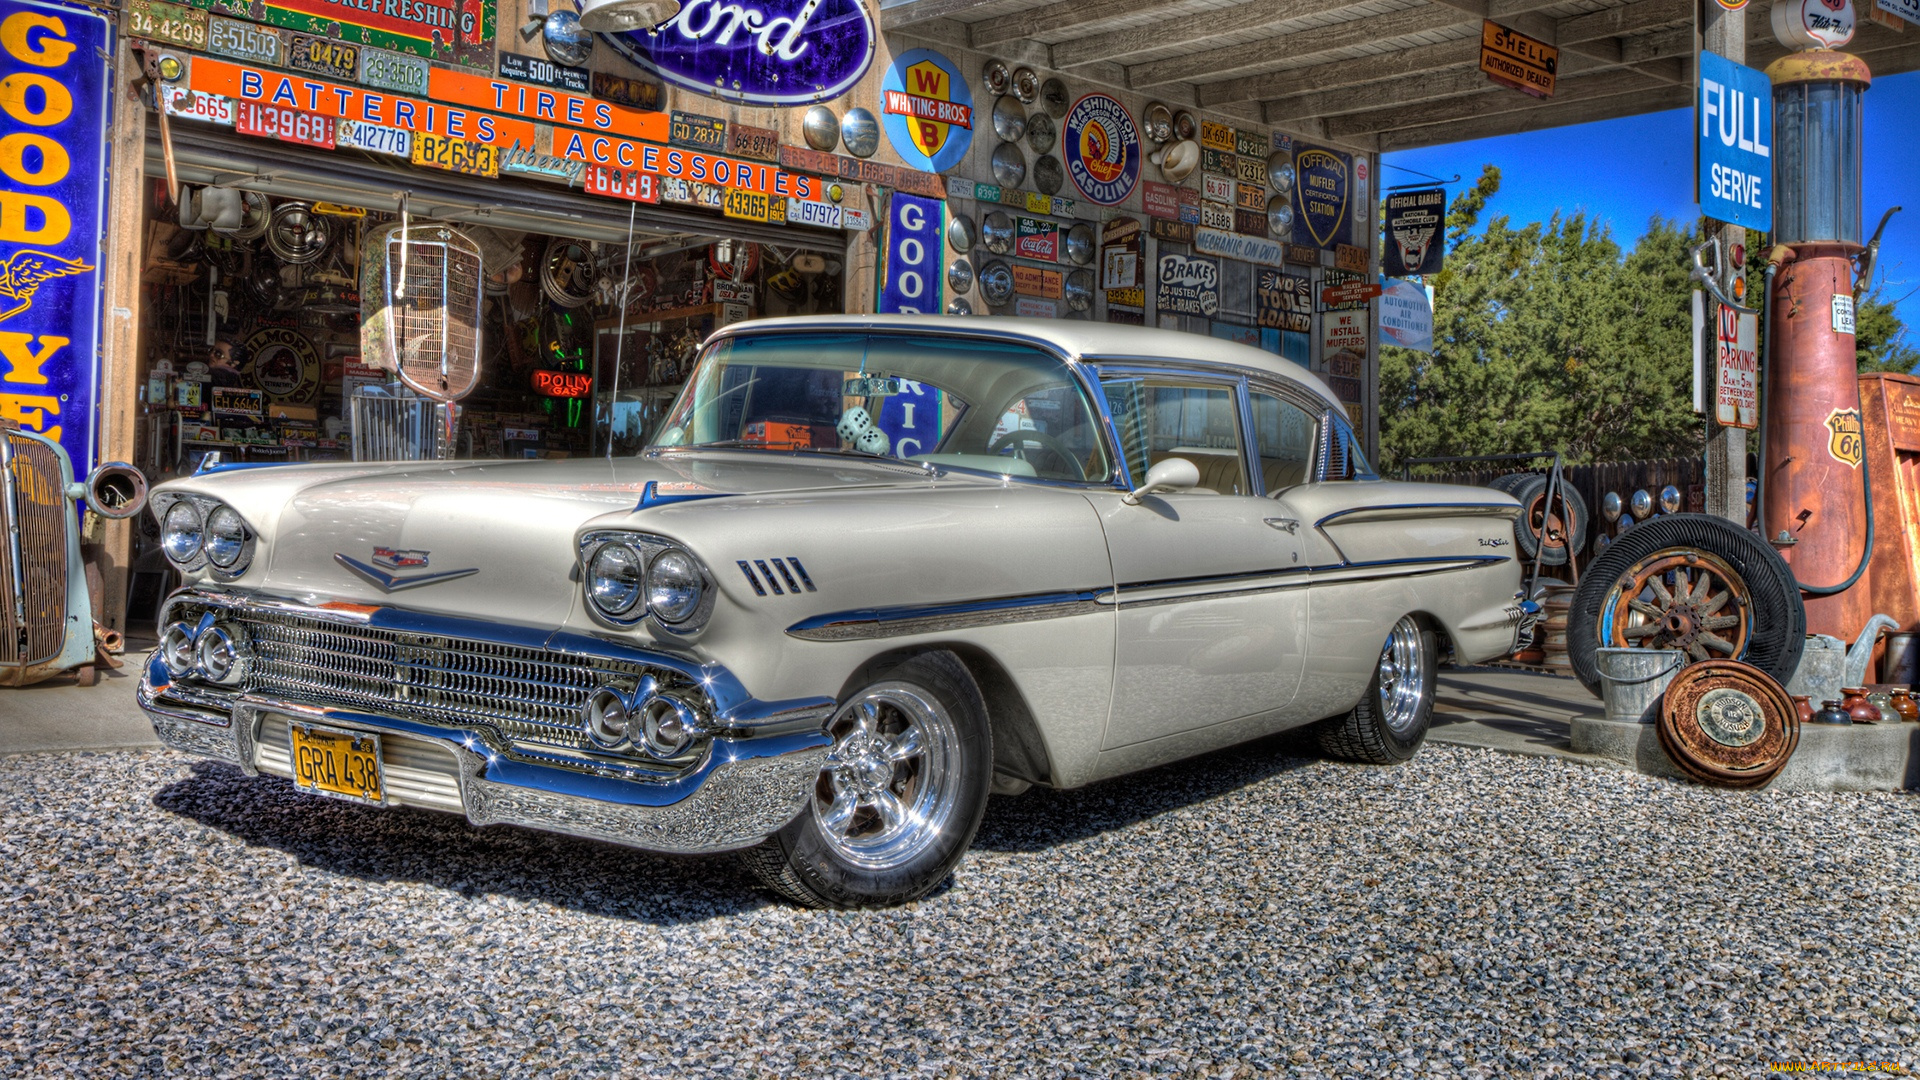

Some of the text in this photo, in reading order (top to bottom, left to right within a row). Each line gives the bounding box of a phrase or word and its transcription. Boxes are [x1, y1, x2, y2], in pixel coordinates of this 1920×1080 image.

[648, 0, 808, 60] ord
[309, 40, 355, 70] 0479
[1494, 31, 1547, 63] SHELL
[507, 55, 523, 67] Law
[500, 64, 527, 78] Requires
[529, 59, 553, 83] 500
[1485, 54, 1551, 88] AUTHORIZED DEALER
[565, 77, 586, 90] Trucks
[914, 68, 941, 95] W
[241, 68, 496, 143] BATTERIES
[490, 82, 612, 129] TIRES
[888, 91, 968, 124] WHITING BROS.
[1069, 97, 1137, 145] WASHINGTON
[1702, 77, 1770, 158] FULL
[353, 124, 406, 154] 412778
[673, 123, 722, 145] GD 2837
[920, 121, 939, 148] B
[502, 138, 584, 188] Liberty
[565, 132, 812, 199] ACCESSORIES
[1090, 159, 1122, 181] Chief
[1302, 154, 1343, 179] OFFICIAL
[1071, 159, 1133, 201] GASOLINE
[1309, 174, 1336, 192] MUFFLER
[1710, 162, 1762, 210] SERVE
[726, 192, 766, 218] 43365
[1145, 192, 1177, 208] GASOLINE
[1304, 188, 1340, 203] CERTIFICATION
[1389, 193, 1442, 209] OFFICIAL GARAGE
[801, 202, 840, 226] 197972
[1155, 206, 1175, 214] SMOKING
[1309, 200, 1335, 217] STATION
[1404, 211, 1426, 219] NATIONAL
[1020, 225, 1038, 234] TODAY
[1022, 218, 1034, 227] GAS
[1394, 216, 1436, 226] AUTOMOBILE CLUB
[1154, 220, 1191, 242] AL SMITH
[1196, 230, 1282, 263] MECHANIC ON DUTY
[1015, 271, 1059, 286] NO ADMITTANCE
[1162, 257, 1216, 287] BRAKES
[1274, 275, 1295, 292] NO
[1331, 289, 1352, 297] EXHAUST
[1342, 282, 1362, 290] WALKER
[1177, 298, 1200, 314] BRAKES
[1258, 287, 1312, 315] TOOLS
[1342, 293, 1362, 301] SERVICE
[1384, 296, 1427, 313] AUTOMOTIVE
[1258, 308, 1311, 332] LOANED
[1339, 315, 1352, 326] WE
[1400, 309, 1412, 319] AIR
[1720, 308, 1737, 339] NO
[1330, 327, 1361, 337] INSTALL
[1382, 315, 1428, 333] CONDITIONER
[1325, 336, 1365, 349] MUFFLERS
[345, 361, 367, 370] SUPER
[1720, 346, 1755, 373] PARKING
[348, 370, 383, 378] MAGAZINE
[537, 372, 593, 393] POLLY
[1722, 369, 1729, 385] 8
[1740, 373, 1746, 388] 5
[552, 386, 579, 396] GAS
[1720, 385, 1755, 400] BETWEEN SIGNS
[233, 397, 259, 411] 6646
[1719, 395, 1755, 410] ON SCHOOL DAYS
[1840, 434, 1861, 459] 66
[1715, 697, 1748, 711] HUDSON
[1717, 719, 1750, 731] HUDSON
[300, 745, 378, 793] GRA 438
